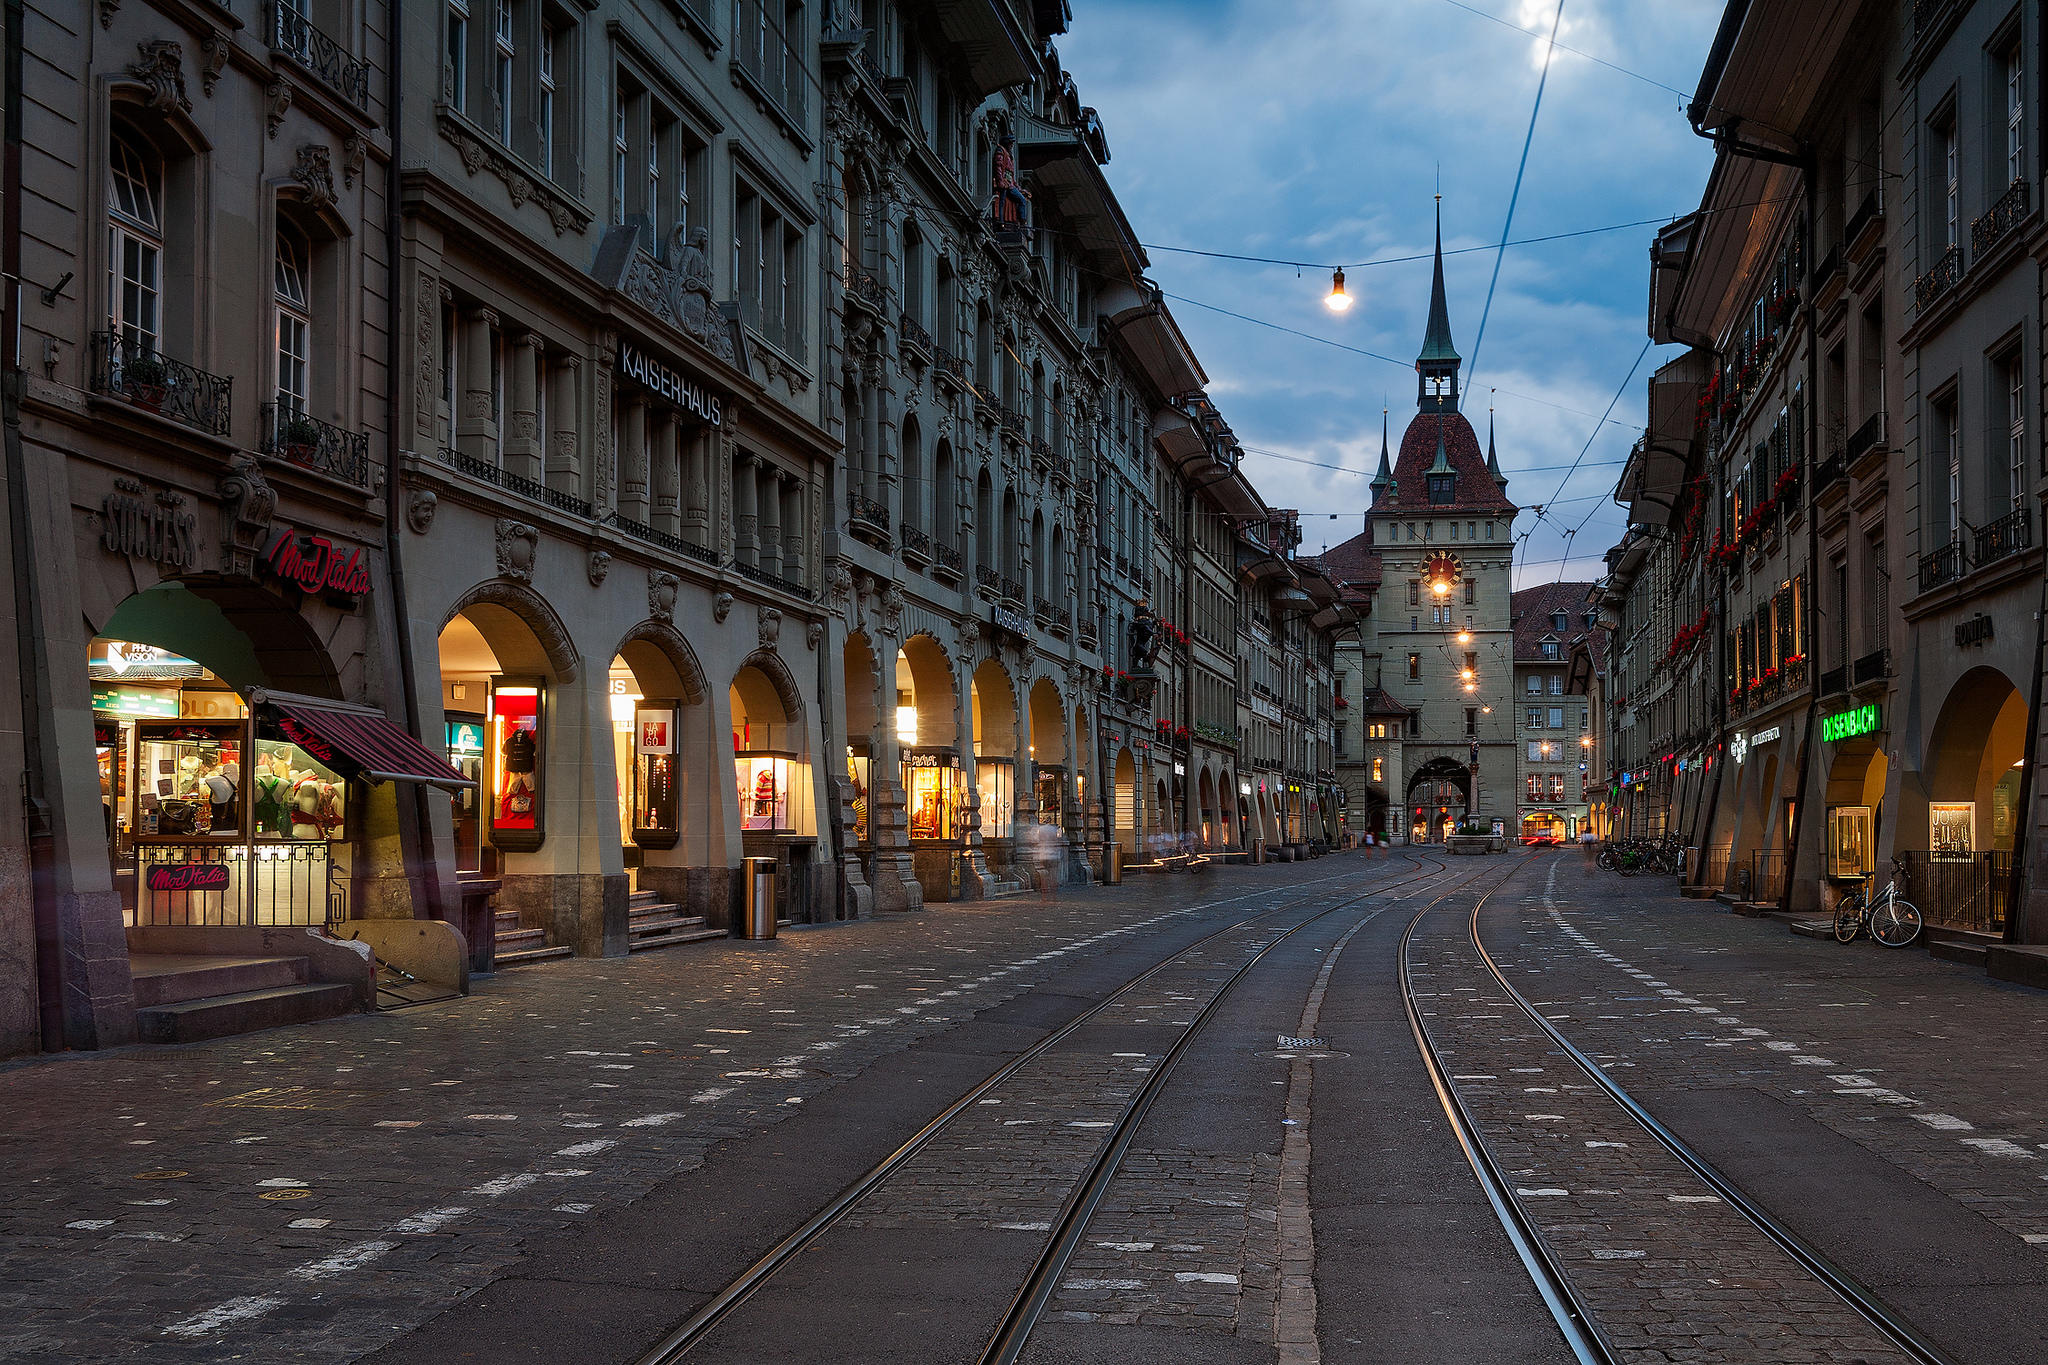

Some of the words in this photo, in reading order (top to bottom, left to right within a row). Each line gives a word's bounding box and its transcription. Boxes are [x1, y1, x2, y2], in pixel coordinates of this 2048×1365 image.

[622, 342, 721, 426] KAISERHAUS
[103, 494, 198, 569] SUCCESS
[995, 605, 1030, 638] KAISERHAUS
[125, 652, 158, 662] VISION
[1823, 704, 1875, 742] DOSENBACH
